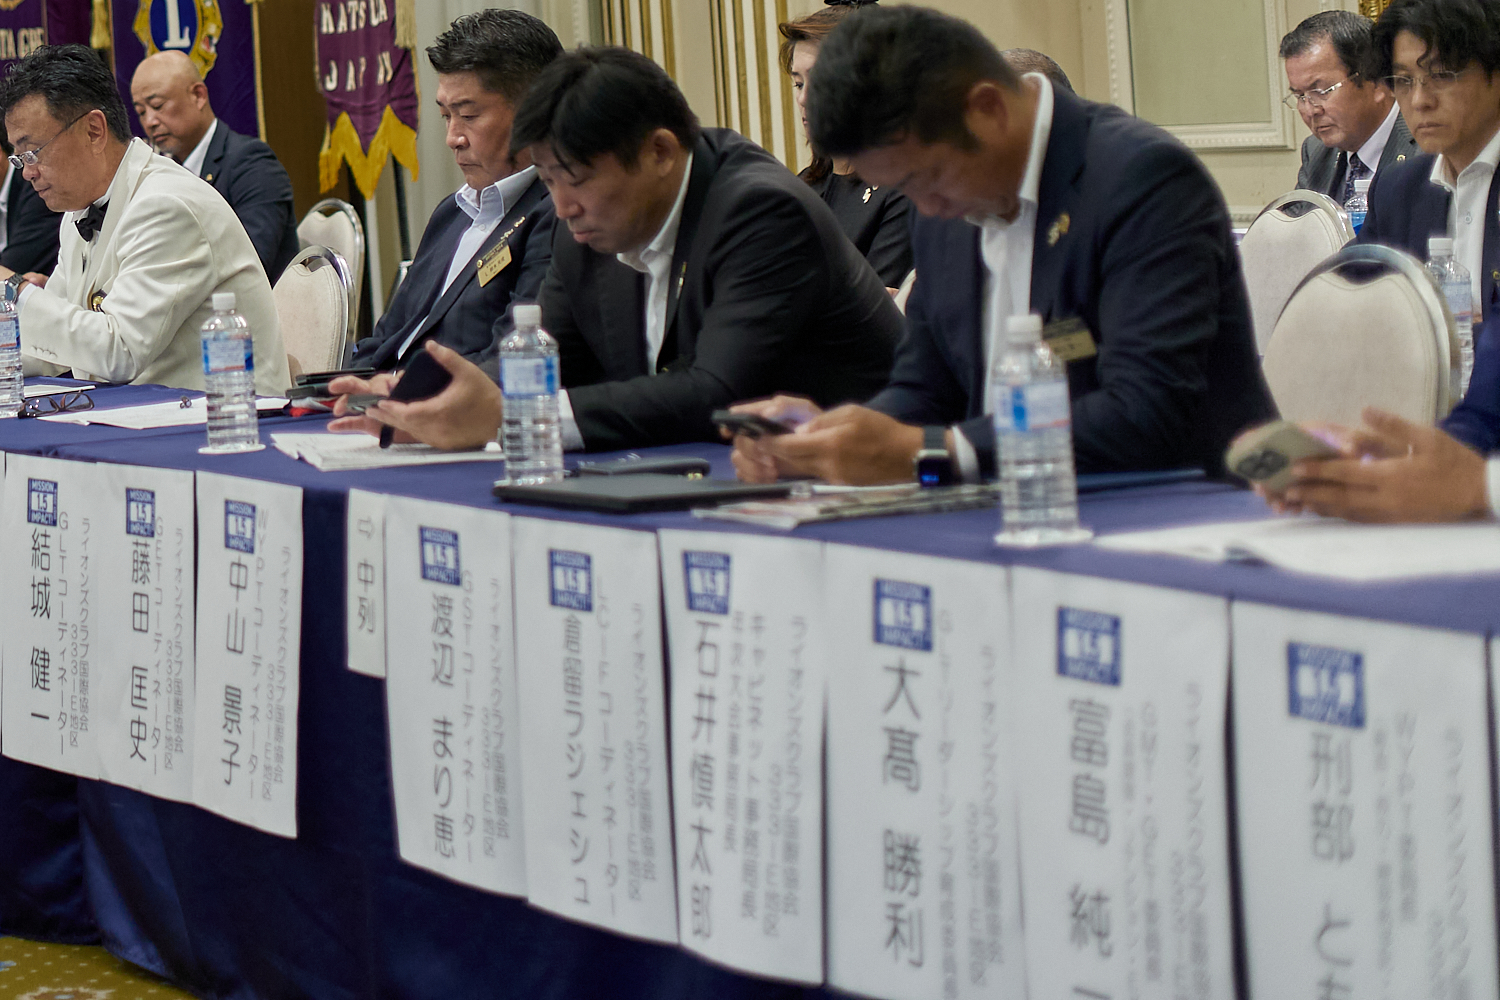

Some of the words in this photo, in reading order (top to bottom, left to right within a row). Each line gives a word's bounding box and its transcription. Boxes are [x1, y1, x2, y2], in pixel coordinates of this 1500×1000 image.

[32, 480, 54, 493] MISSION
[37, 493, 48, 511] 1.5
[129, 490, 151, 501] MISSION
[136, 504, 147, 521] 1.5
[235, 517, 247, 536] 1.5
[31, 527, 51, 620] 結城
[132, 539, 150, 633] 藤田
[357, 559, 376, 634] 中列
[432, 544, 448, 566] 1.5
[226, 555, 248, 655] 中山
[431, 592, 454, 686] 渡辺
[30, 646, 51, 720] 健一
[130, 665, 148, 762] 匡史
[221, 685, 243, 785] 景子
[1068, 696, 1111, 846] 富島
[1315, 900, 1355, 1000] と
